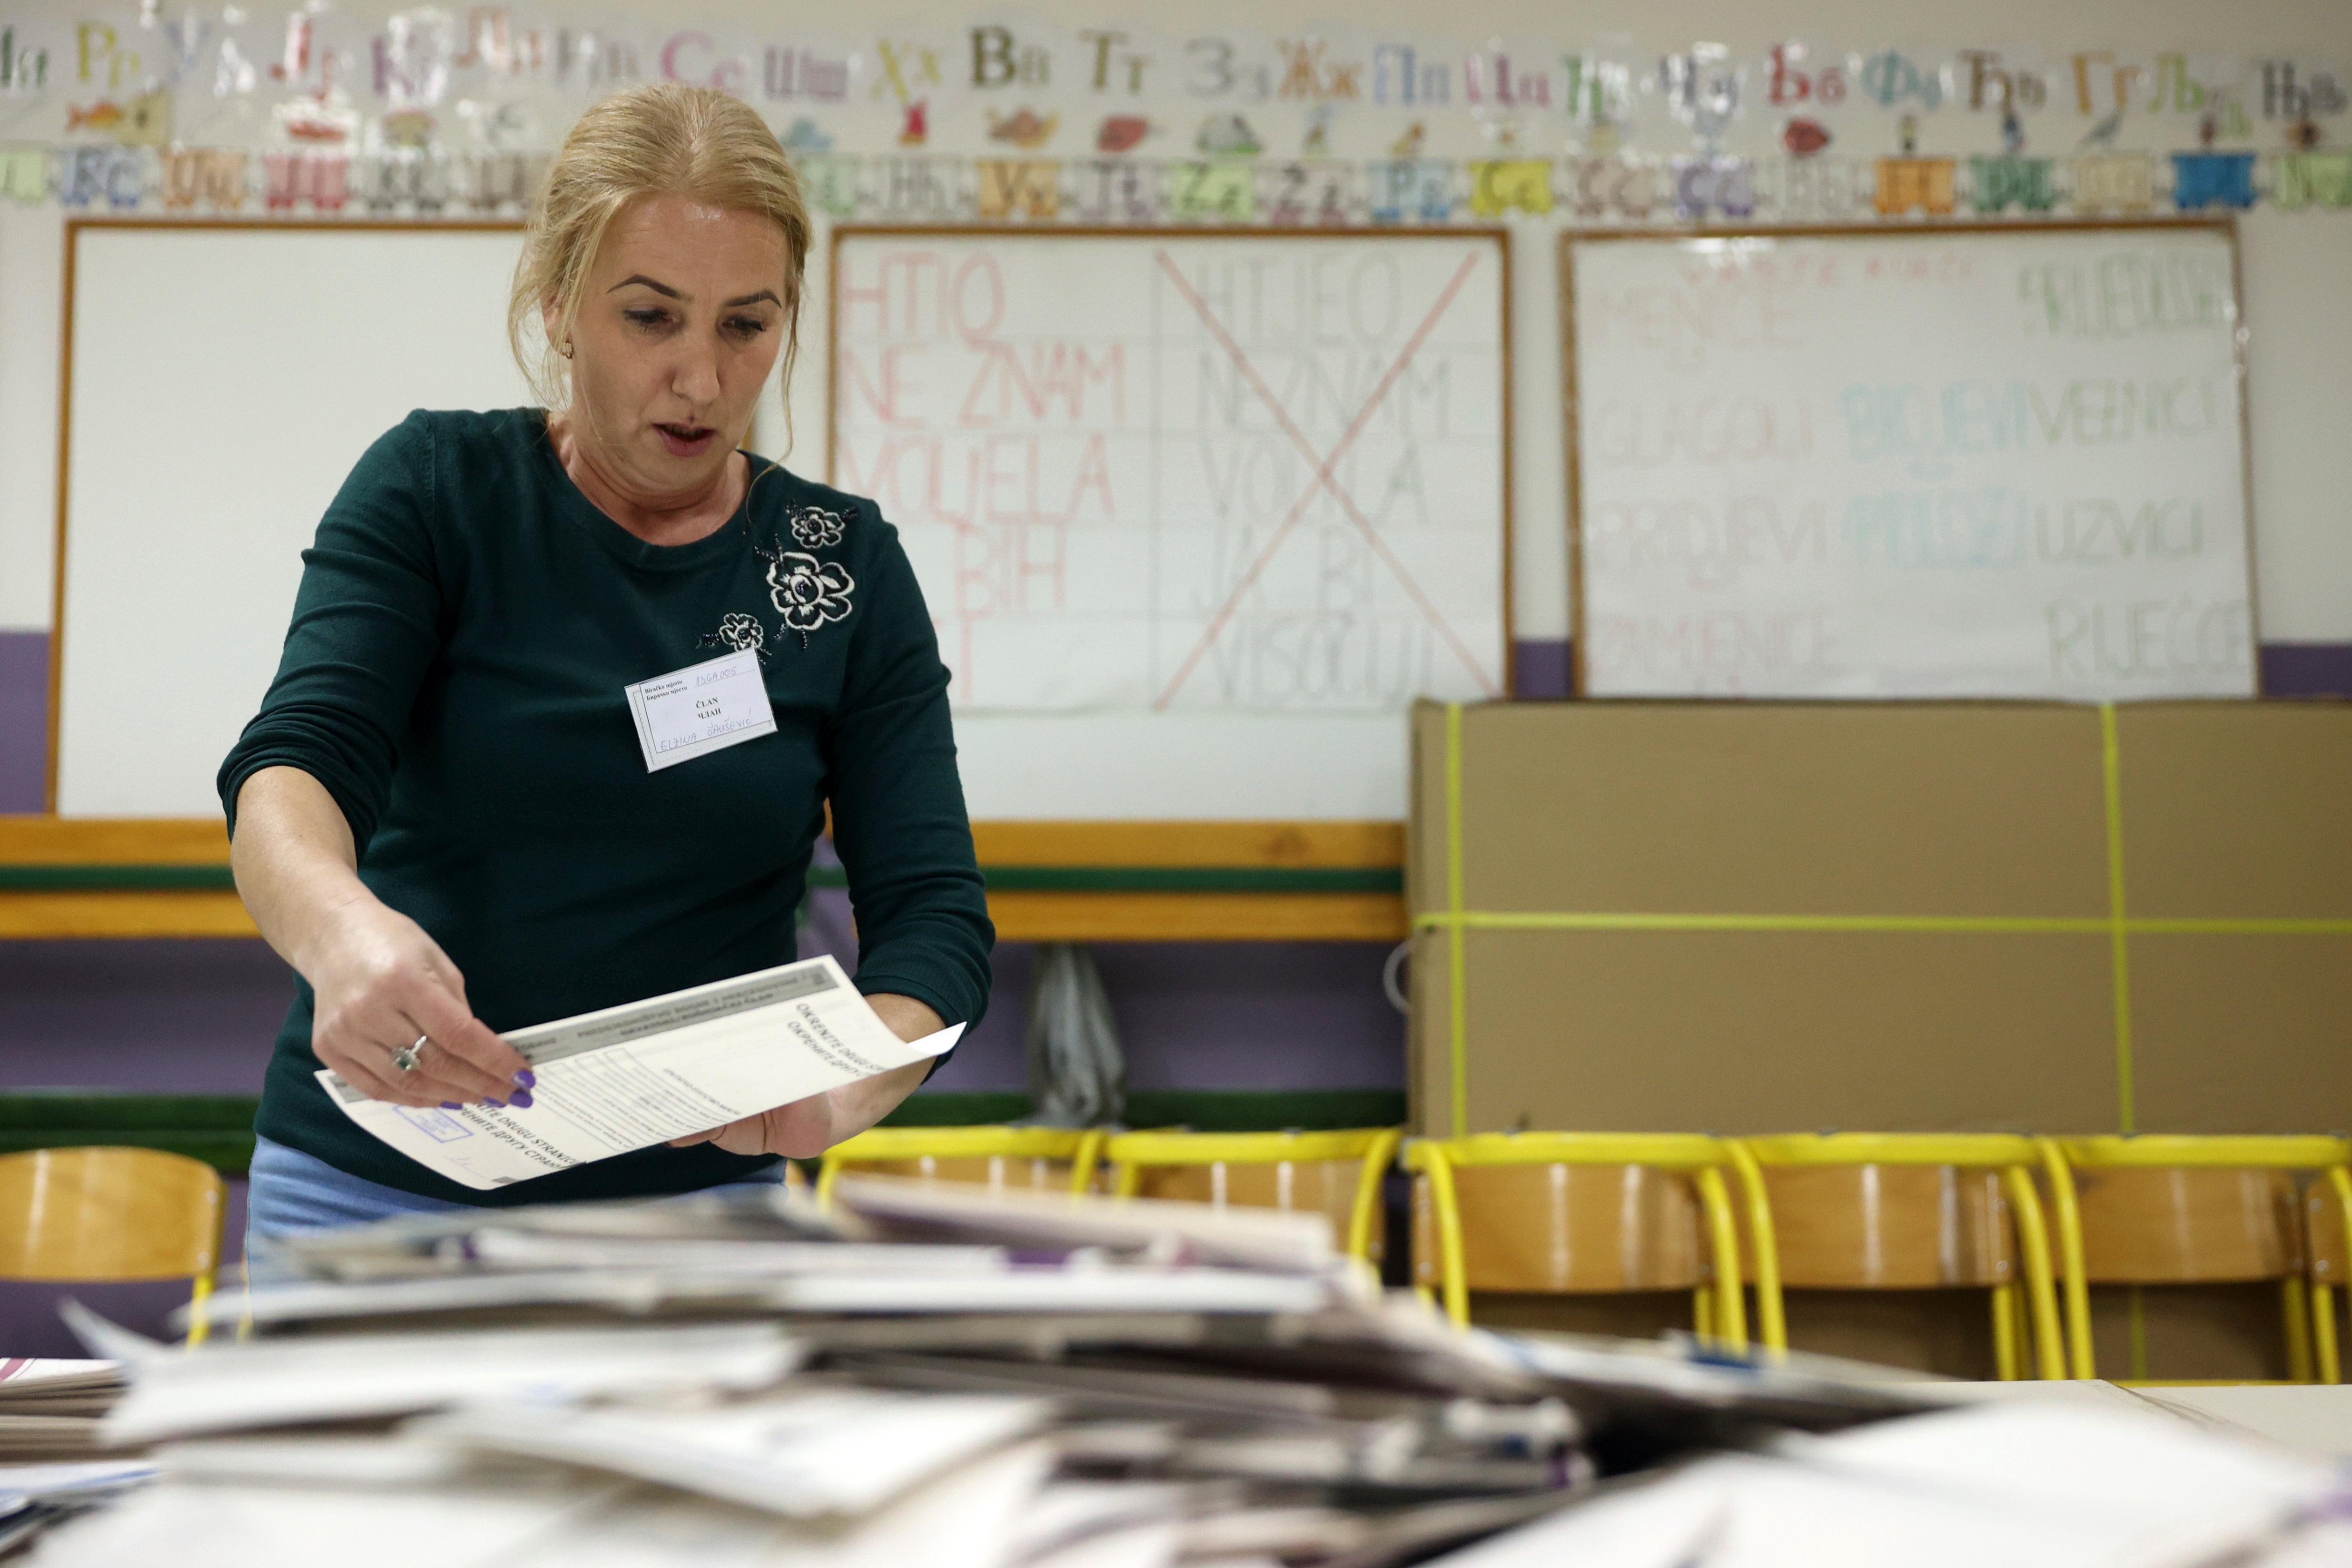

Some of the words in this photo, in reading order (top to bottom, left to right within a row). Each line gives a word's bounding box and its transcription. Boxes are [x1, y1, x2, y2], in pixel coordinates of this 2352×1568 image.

[644, 683, 665, 694] Biračko
[665, 680, 682, 690] mjesto
[646, 690, 670, 701] Бирачко
[670, 686, 688, 696] мјесто
[695, 697, 719, 709] ČLAN
[697, 708, 722, 720] ЧЛАН
[497, 1116, 536, 1139] DRUGU
[490, 1130, 529, 1150] ДРУГУ
